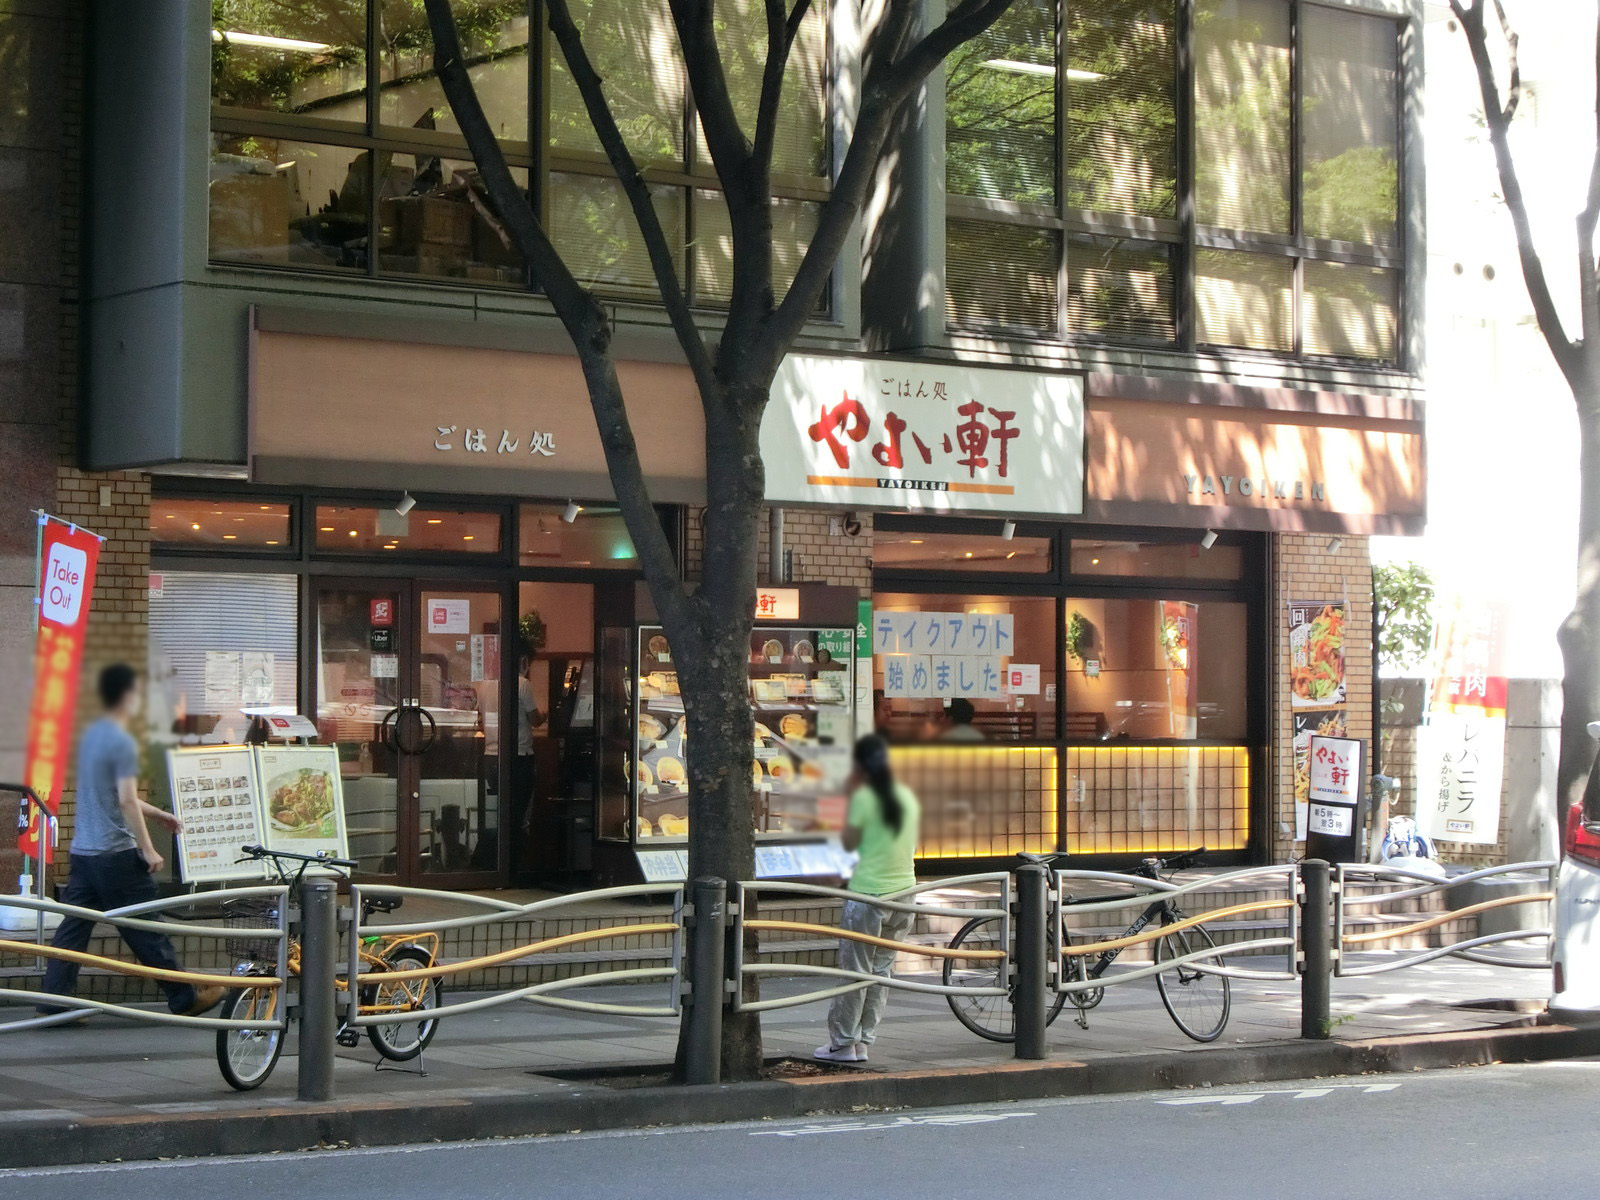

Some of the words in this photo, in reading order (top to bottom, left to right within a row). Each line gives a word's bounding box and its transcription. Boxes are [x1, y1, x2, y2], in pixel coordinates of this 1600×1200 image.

[881, 378, 948, 400] ごはん処
[434, 425, 556, 457] ごはん処
[808, 389, 1020, 478] やよい軒
[879, 479, 947, 491] YAYOIKEN
[1184, 474, 1325, 502] YAYOIKEN
[53, 559, 79, 585] Take
[50, 586, 72, 609] Out
[756, 594, 776, 613] 軒
[878, 618, 1009, 649] テイクアウト
[818, 641, 861, 653] の取り組
[888, 661, 997, 691] 始めました
[1316, 746, 1349, 764] やよい
[1331, 767, 1349, 785] 軒
[1457, 724, 1479, 814] レバニラ
